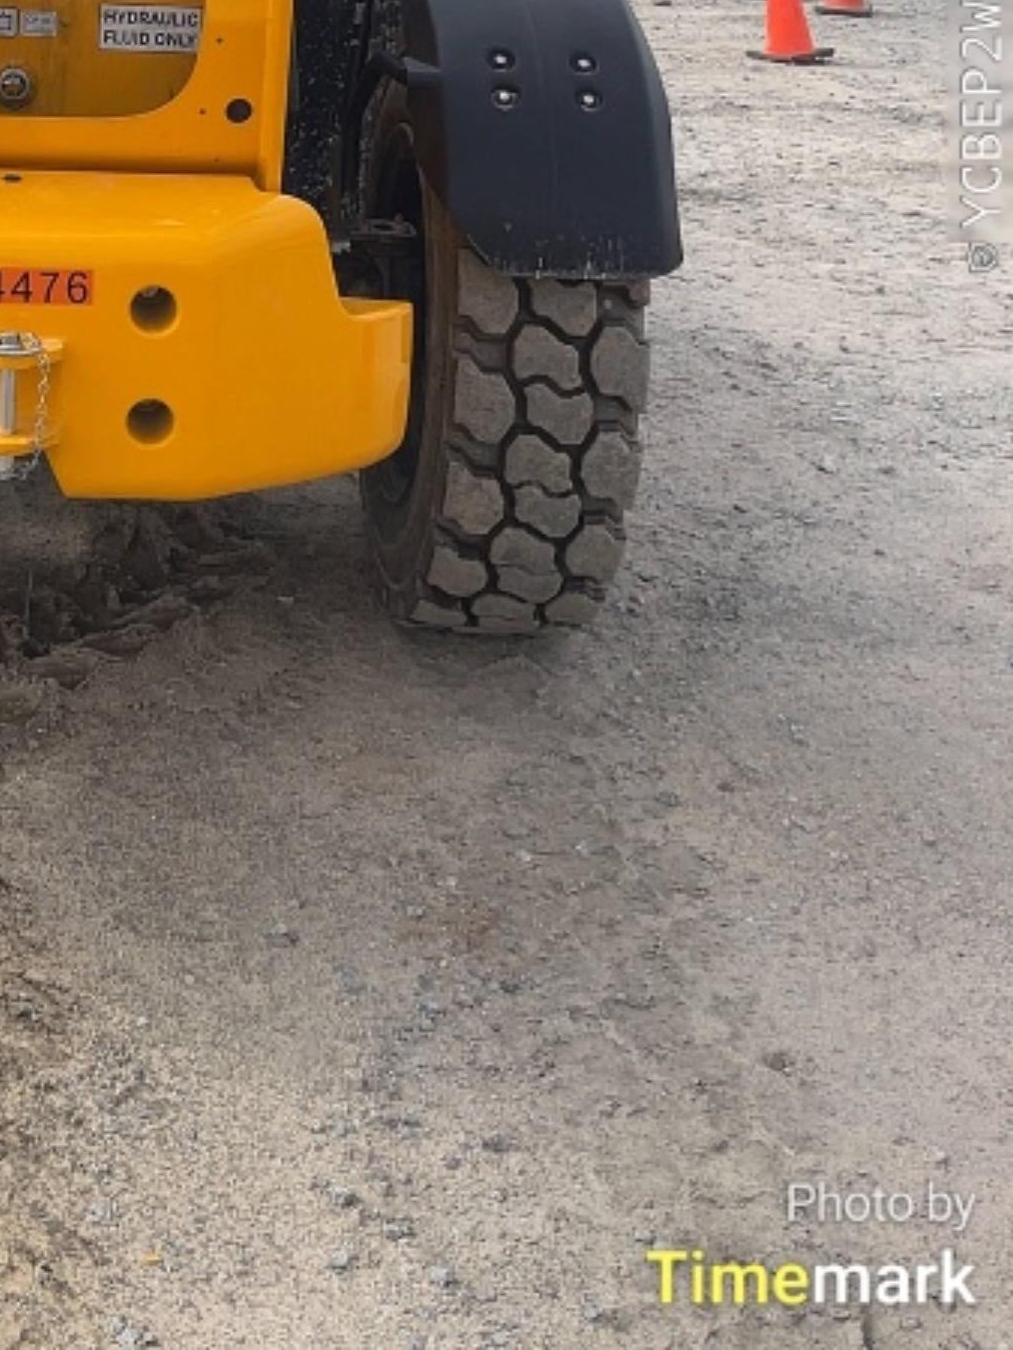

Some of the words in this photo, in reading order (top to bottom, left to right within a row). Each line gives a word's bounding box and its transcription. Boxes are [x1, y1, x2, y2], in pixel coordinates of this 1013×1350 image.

[103, 9, 198, 27] HYDRAULIC
[103, 29, 150, 46] FLUID
[154, 31, 198, 48] ONLY
